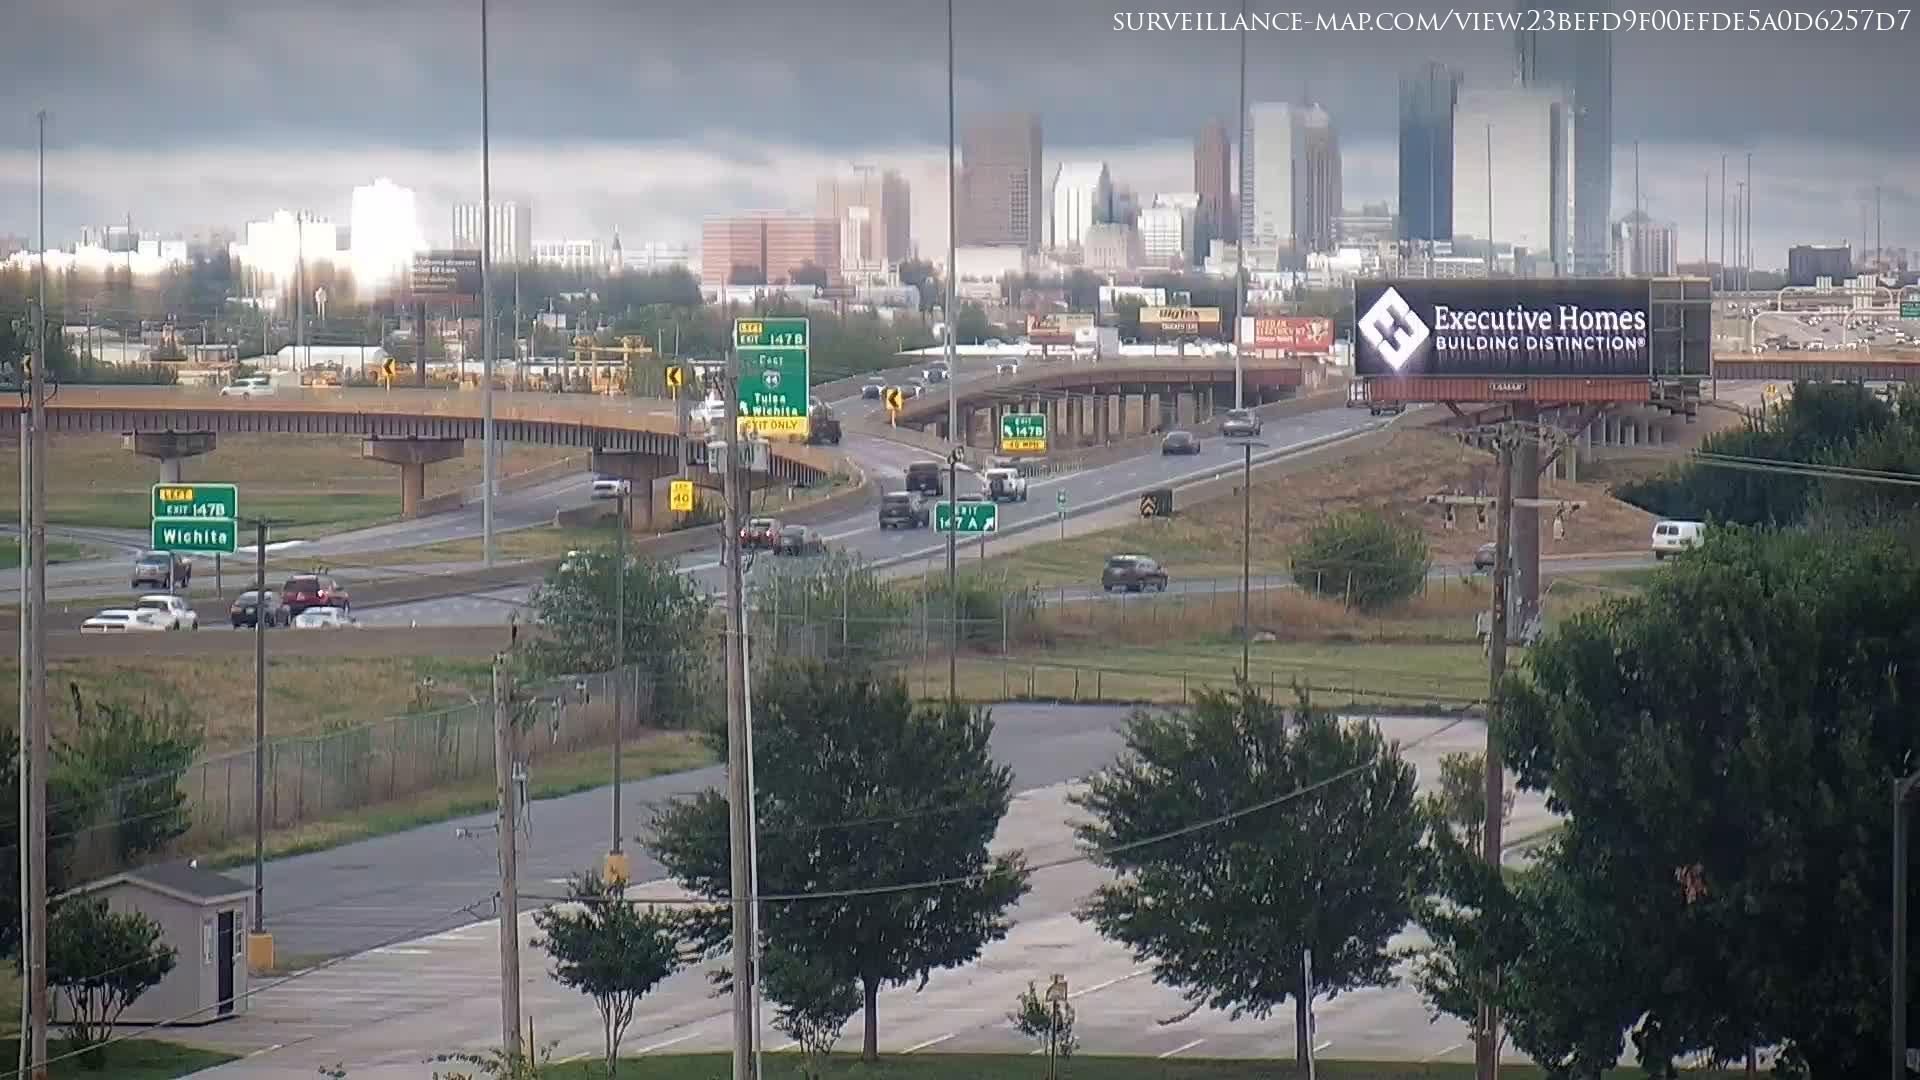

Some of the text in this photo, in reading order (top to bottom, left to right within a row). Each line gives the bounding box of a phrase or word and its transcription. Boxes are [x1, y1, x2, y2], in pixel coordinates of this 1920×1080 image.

[1434, 305, 1646, 331] Executive Homes
[770, 333, 803, 345] 147B
[1436, 336, 1519, 350] BUILDING
[754, 392, 786, 405] Tulsa
[752, 405, 799, 416] Wichita
[770, 420, 798, 430] ONLY
[1016, 426, 1042, 437] 147B
[674, 494, 689, 503] 40
[166, 503, 224, 517] EXIT 147B
[163, 527, 227, 544] Wichita
